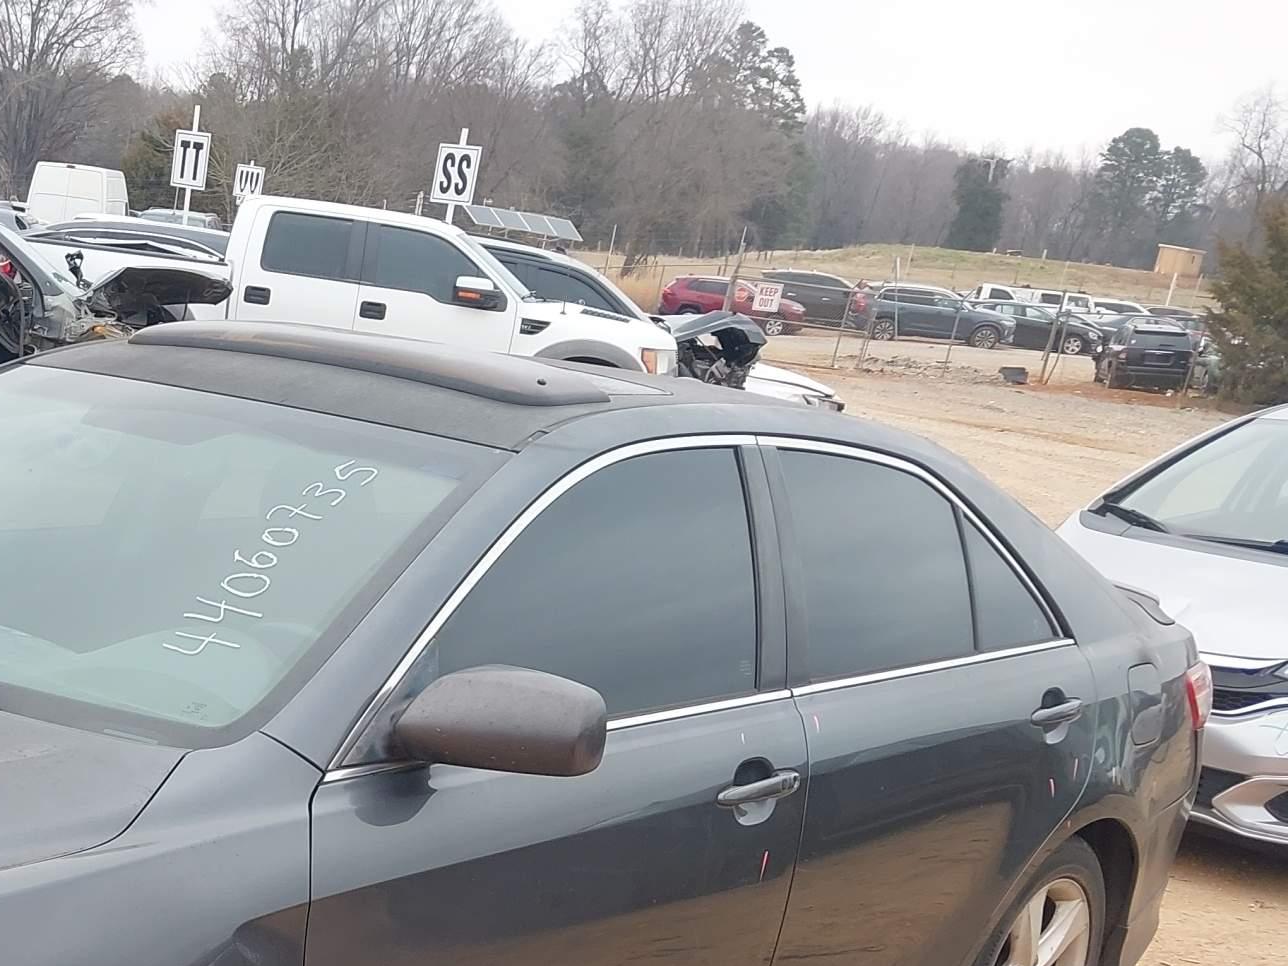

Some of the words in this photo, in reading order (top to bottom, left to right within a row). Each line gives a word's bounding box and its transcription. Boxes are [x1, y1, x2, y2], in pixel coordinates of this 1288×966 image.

[179, 139, 204, 181] TT
[439, 152, 472, 196] SS
[758, 297, 774, 308] OUT
[759, 287, 779, 297] KEEP
[162, 459, 379, 655] 44060735
